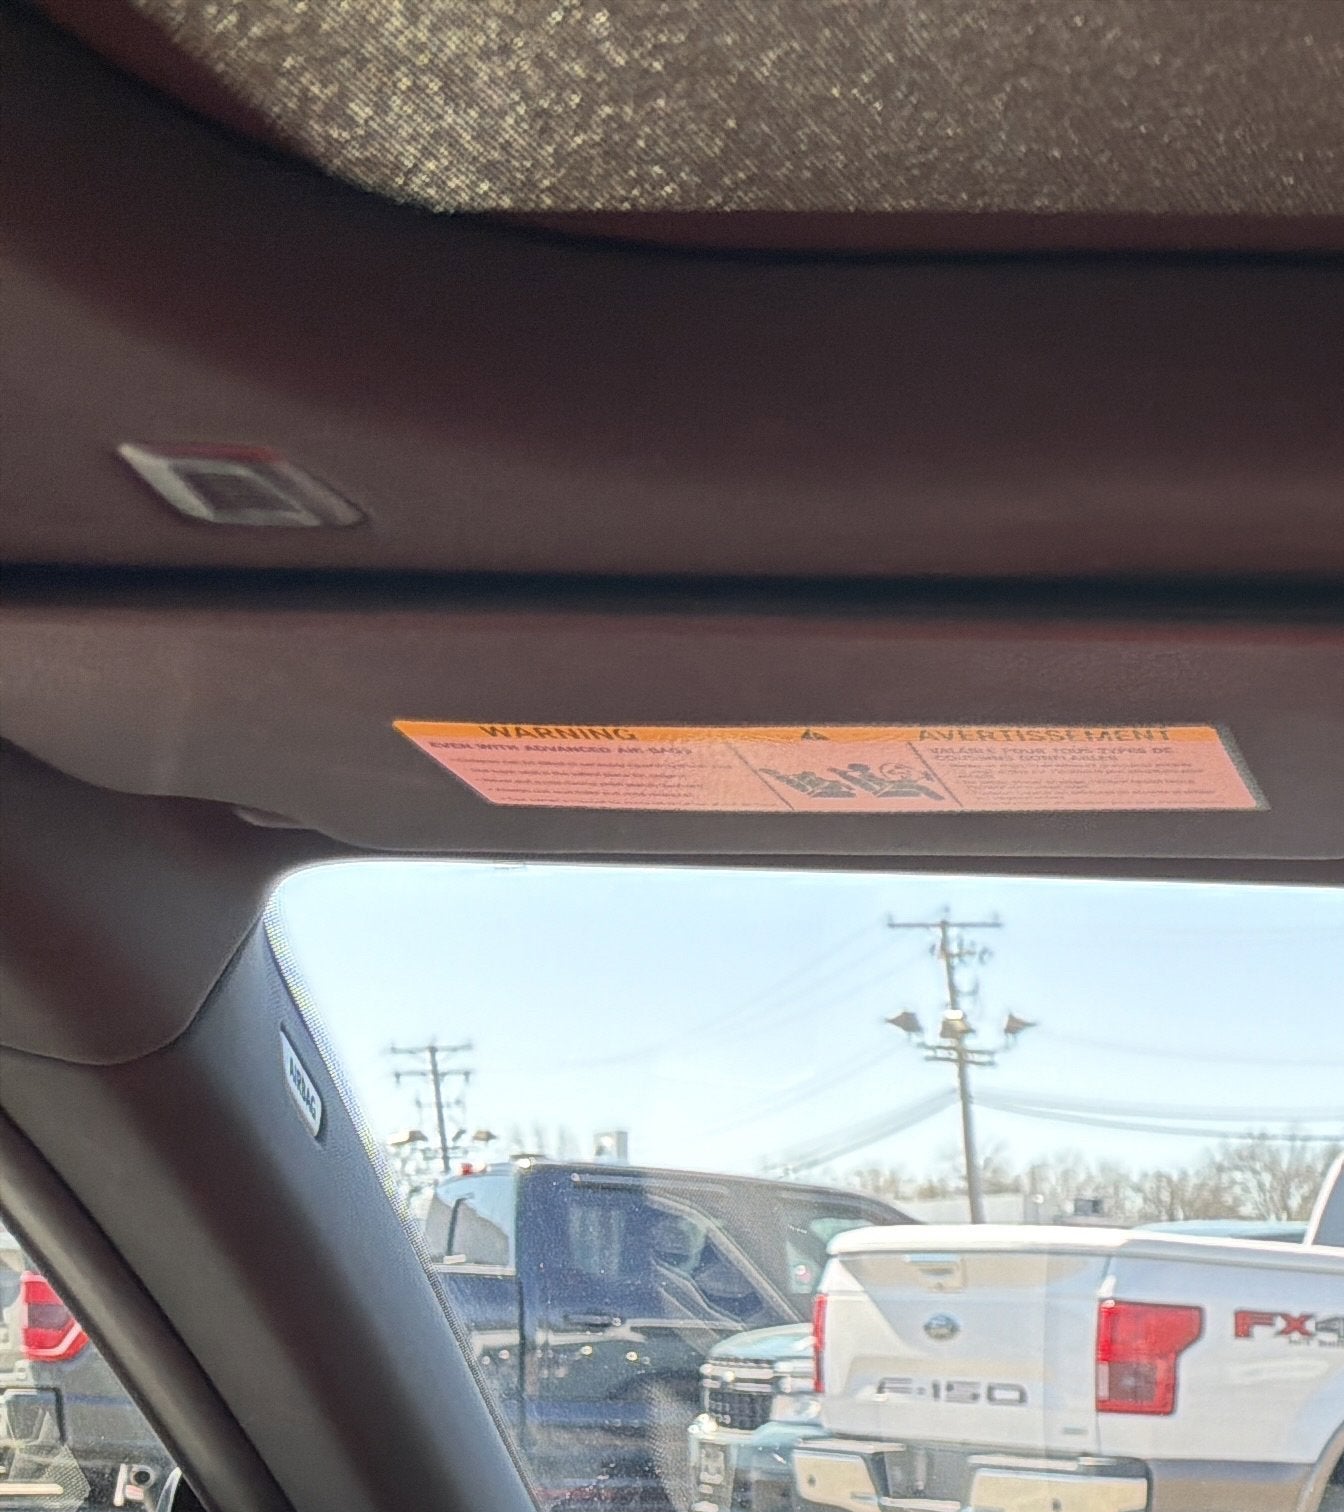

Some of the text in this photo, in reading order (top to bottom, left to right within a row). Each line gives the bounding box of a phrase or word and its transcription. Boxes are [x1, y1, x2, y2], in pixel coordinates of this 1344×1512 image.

[479, 726, 637, 741] WARNING
[919, 729, 1172, 742] AVERTISSEMENT
[876, 1377, 1028, 1406] F-150
